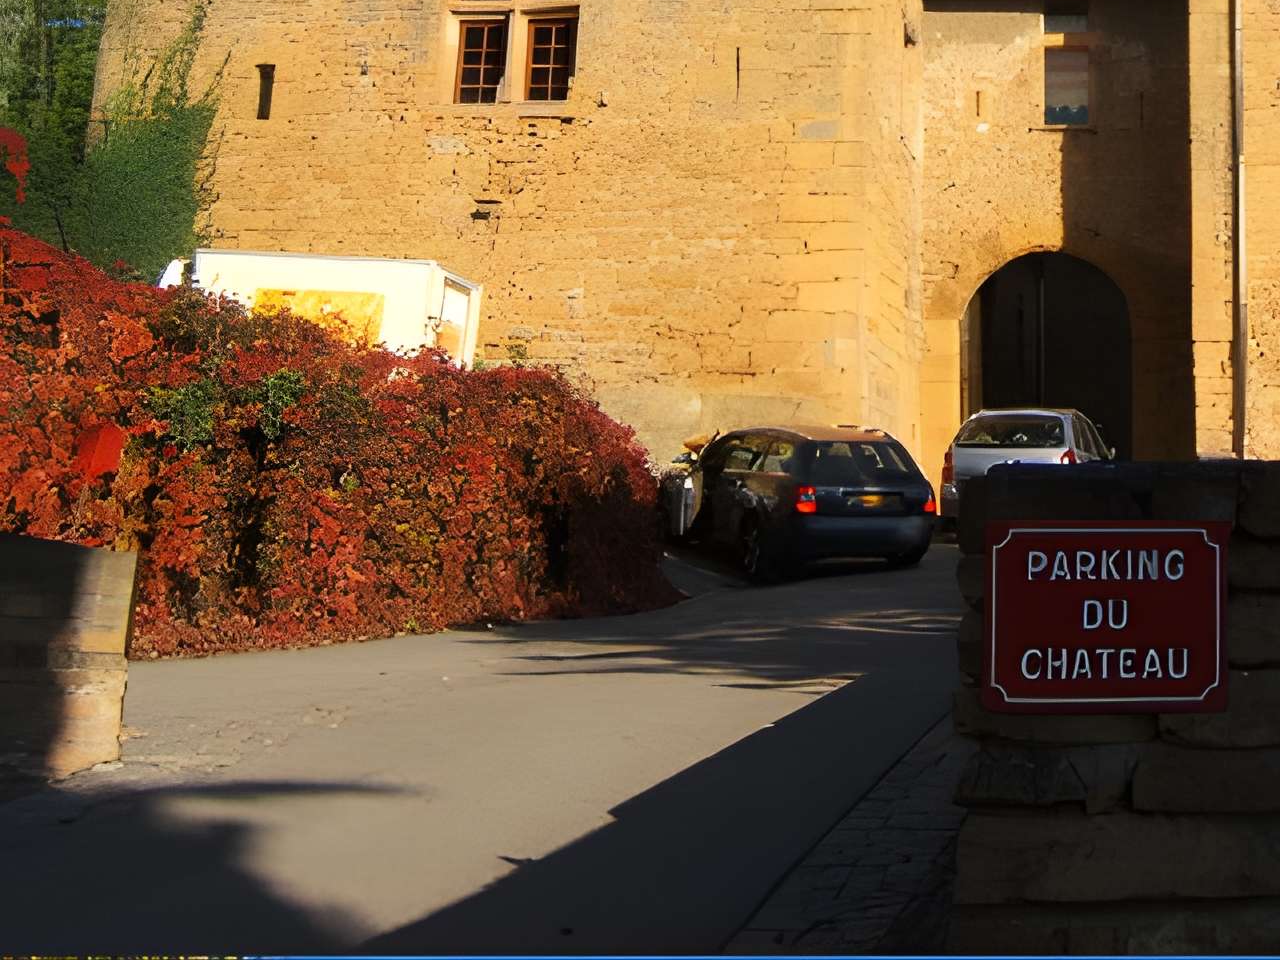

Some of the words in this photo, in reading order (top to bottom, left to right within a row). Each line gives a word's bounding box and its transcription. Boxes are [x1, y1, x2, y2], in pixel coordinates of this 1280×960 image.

[1027, 549, 1185, 581] PARKING
[1083, 599, 1128, 629] DU
[1021, 648, 1188, 680] CHATEAU
